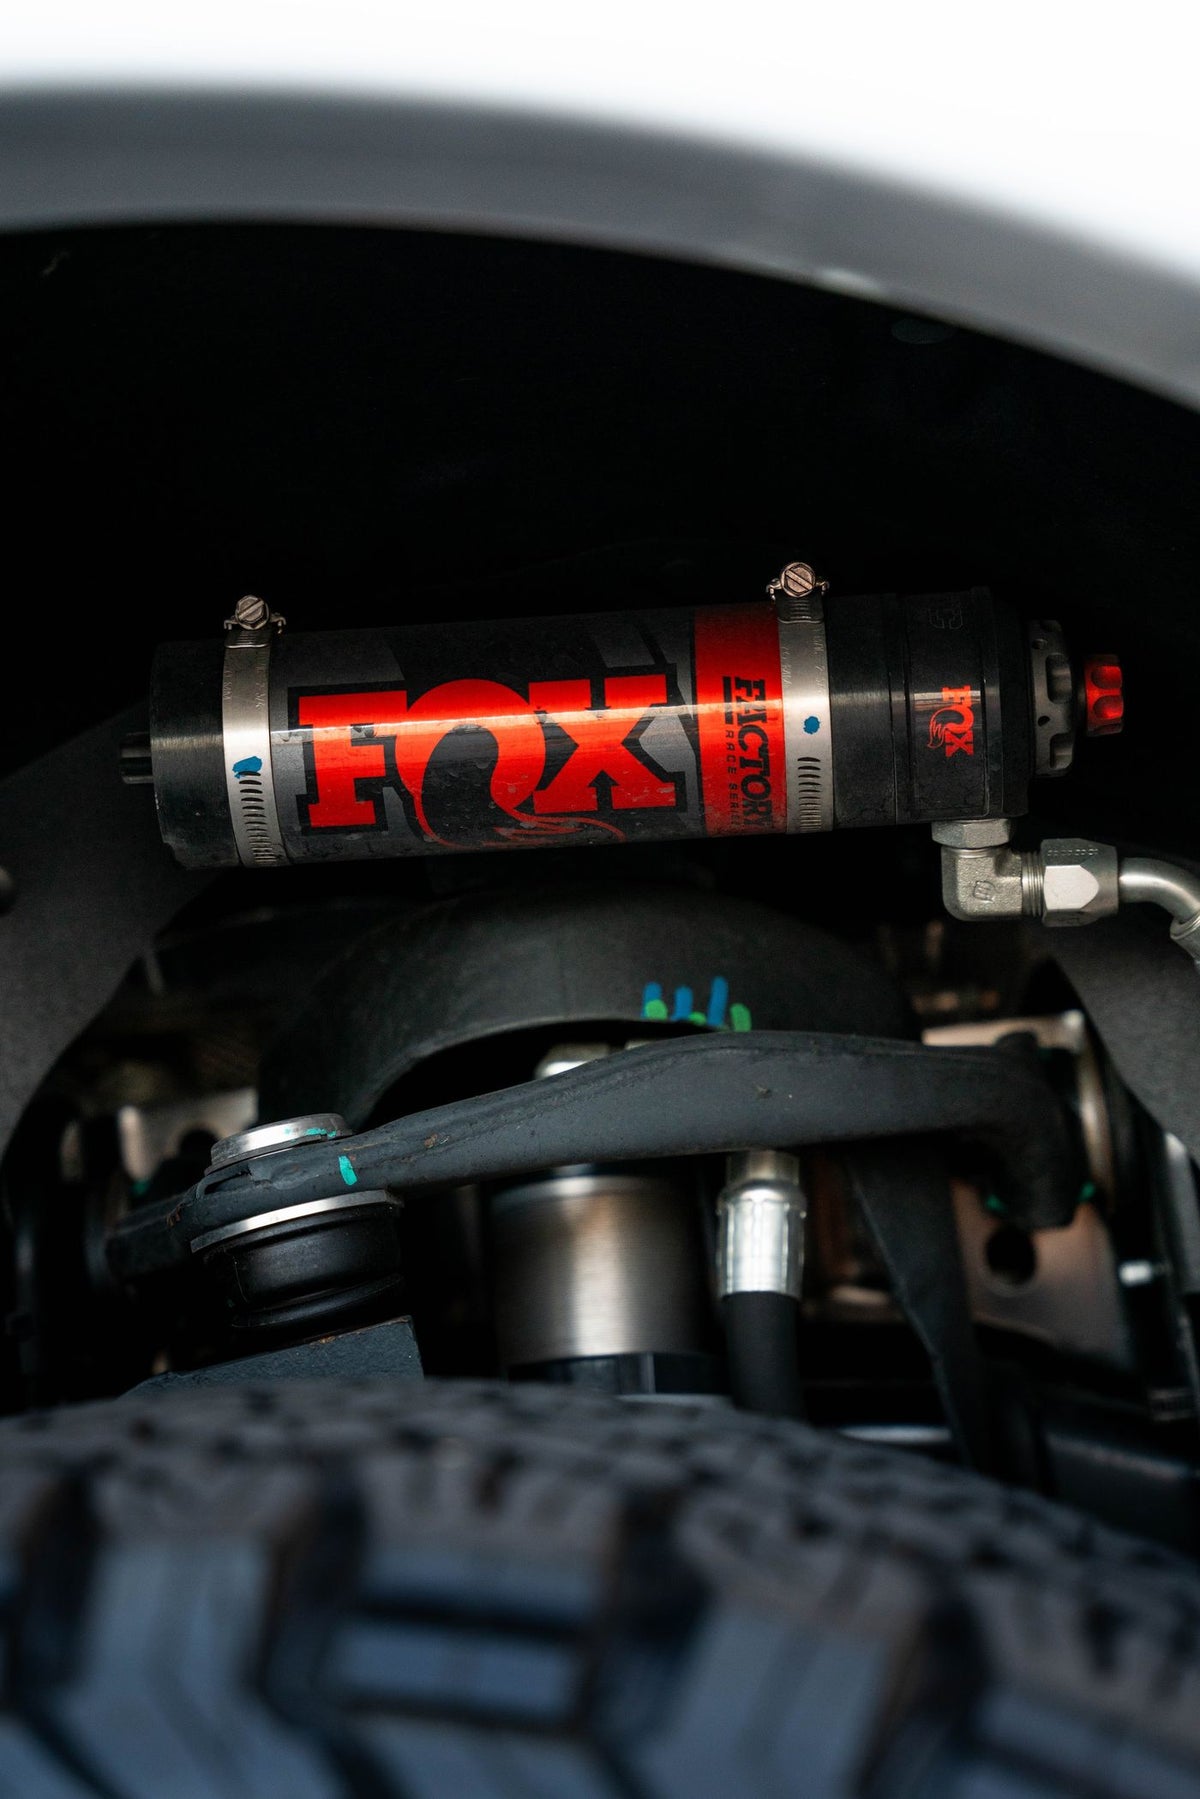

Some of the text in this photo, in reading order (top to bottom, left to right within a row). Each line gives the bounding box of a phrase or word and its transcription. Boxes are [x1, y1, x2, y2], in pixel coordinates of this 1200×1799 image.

[299, 675, 676, 847] FOX
[726, 729, 737, 775] RACE
[734, 677, 773, 826] FACTORY
[927, 685, 974, 757] FOX
